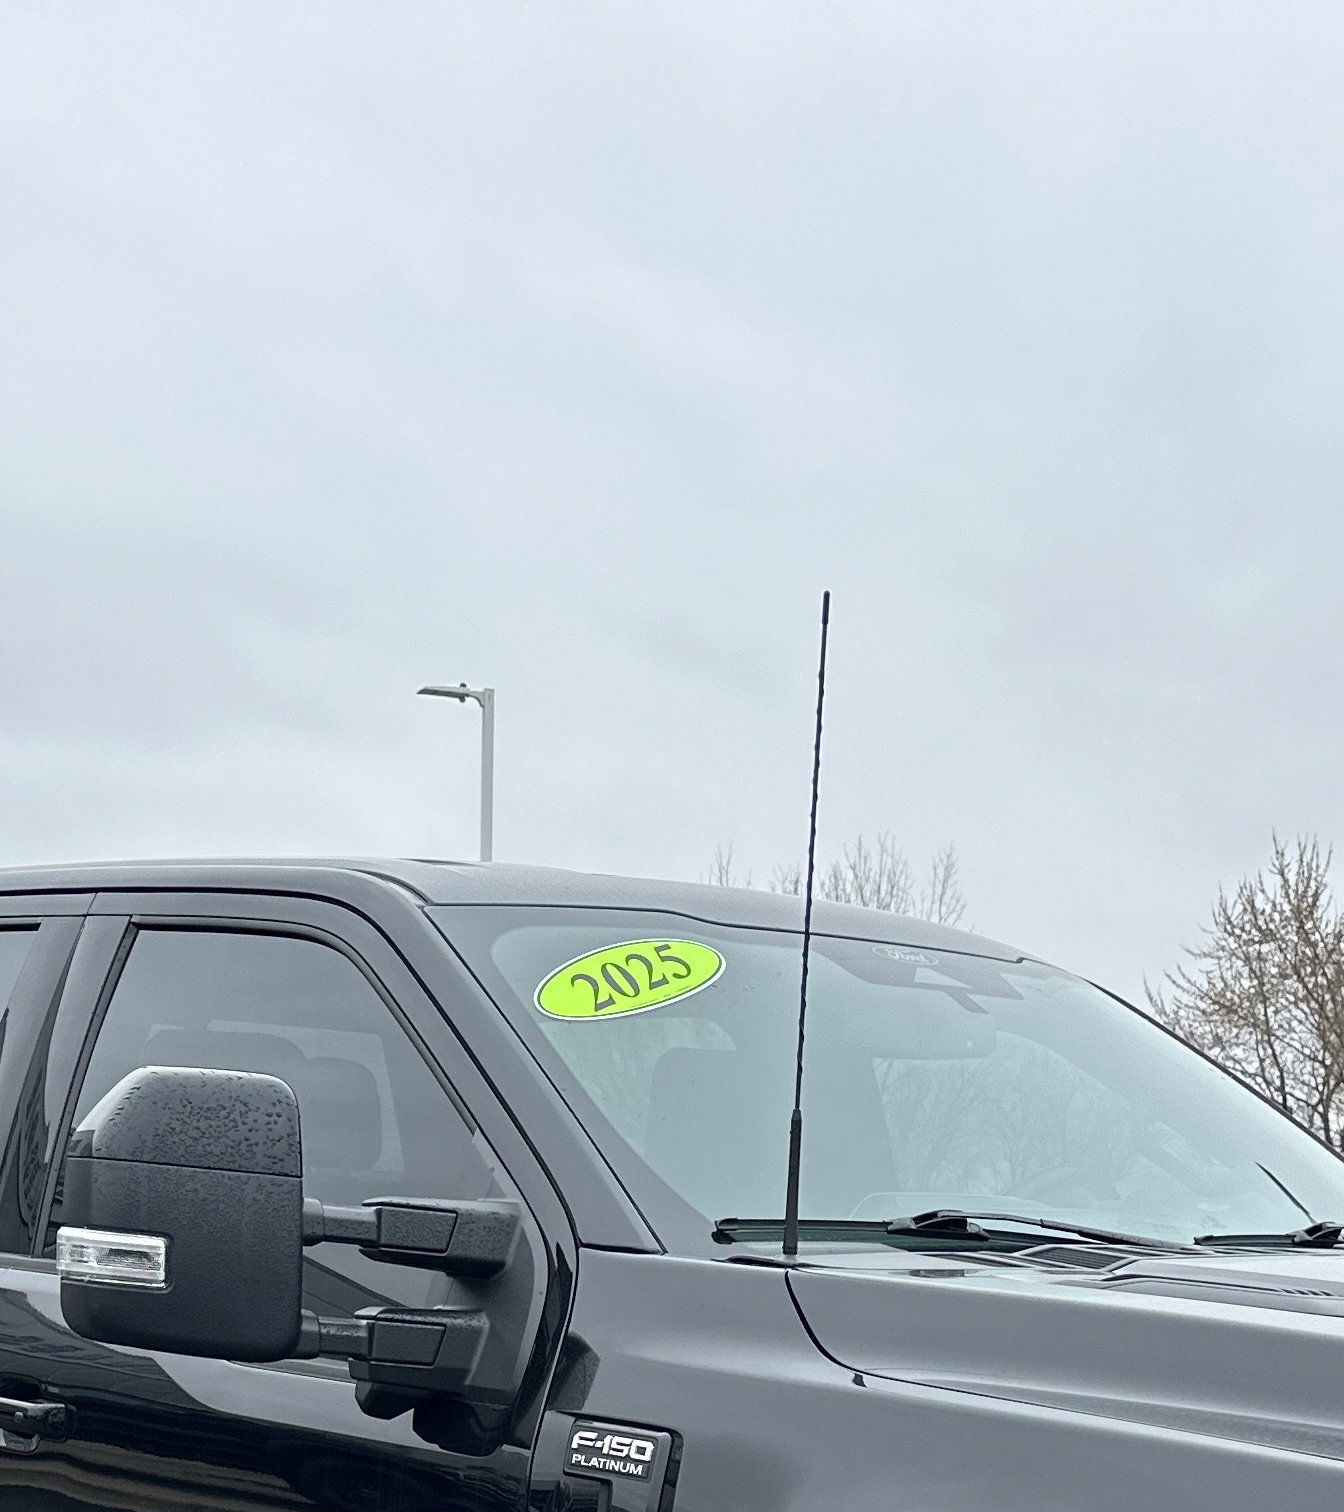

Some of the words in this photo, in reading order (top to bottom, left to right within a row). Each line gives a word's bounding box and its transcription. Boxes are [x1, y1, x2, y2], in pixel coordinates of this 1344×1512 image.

[570, 944, 692, 1013] 2025
[571, 1431, 654, 1461] F-150
[571, 1453, 644, 1475] PLATINUM
